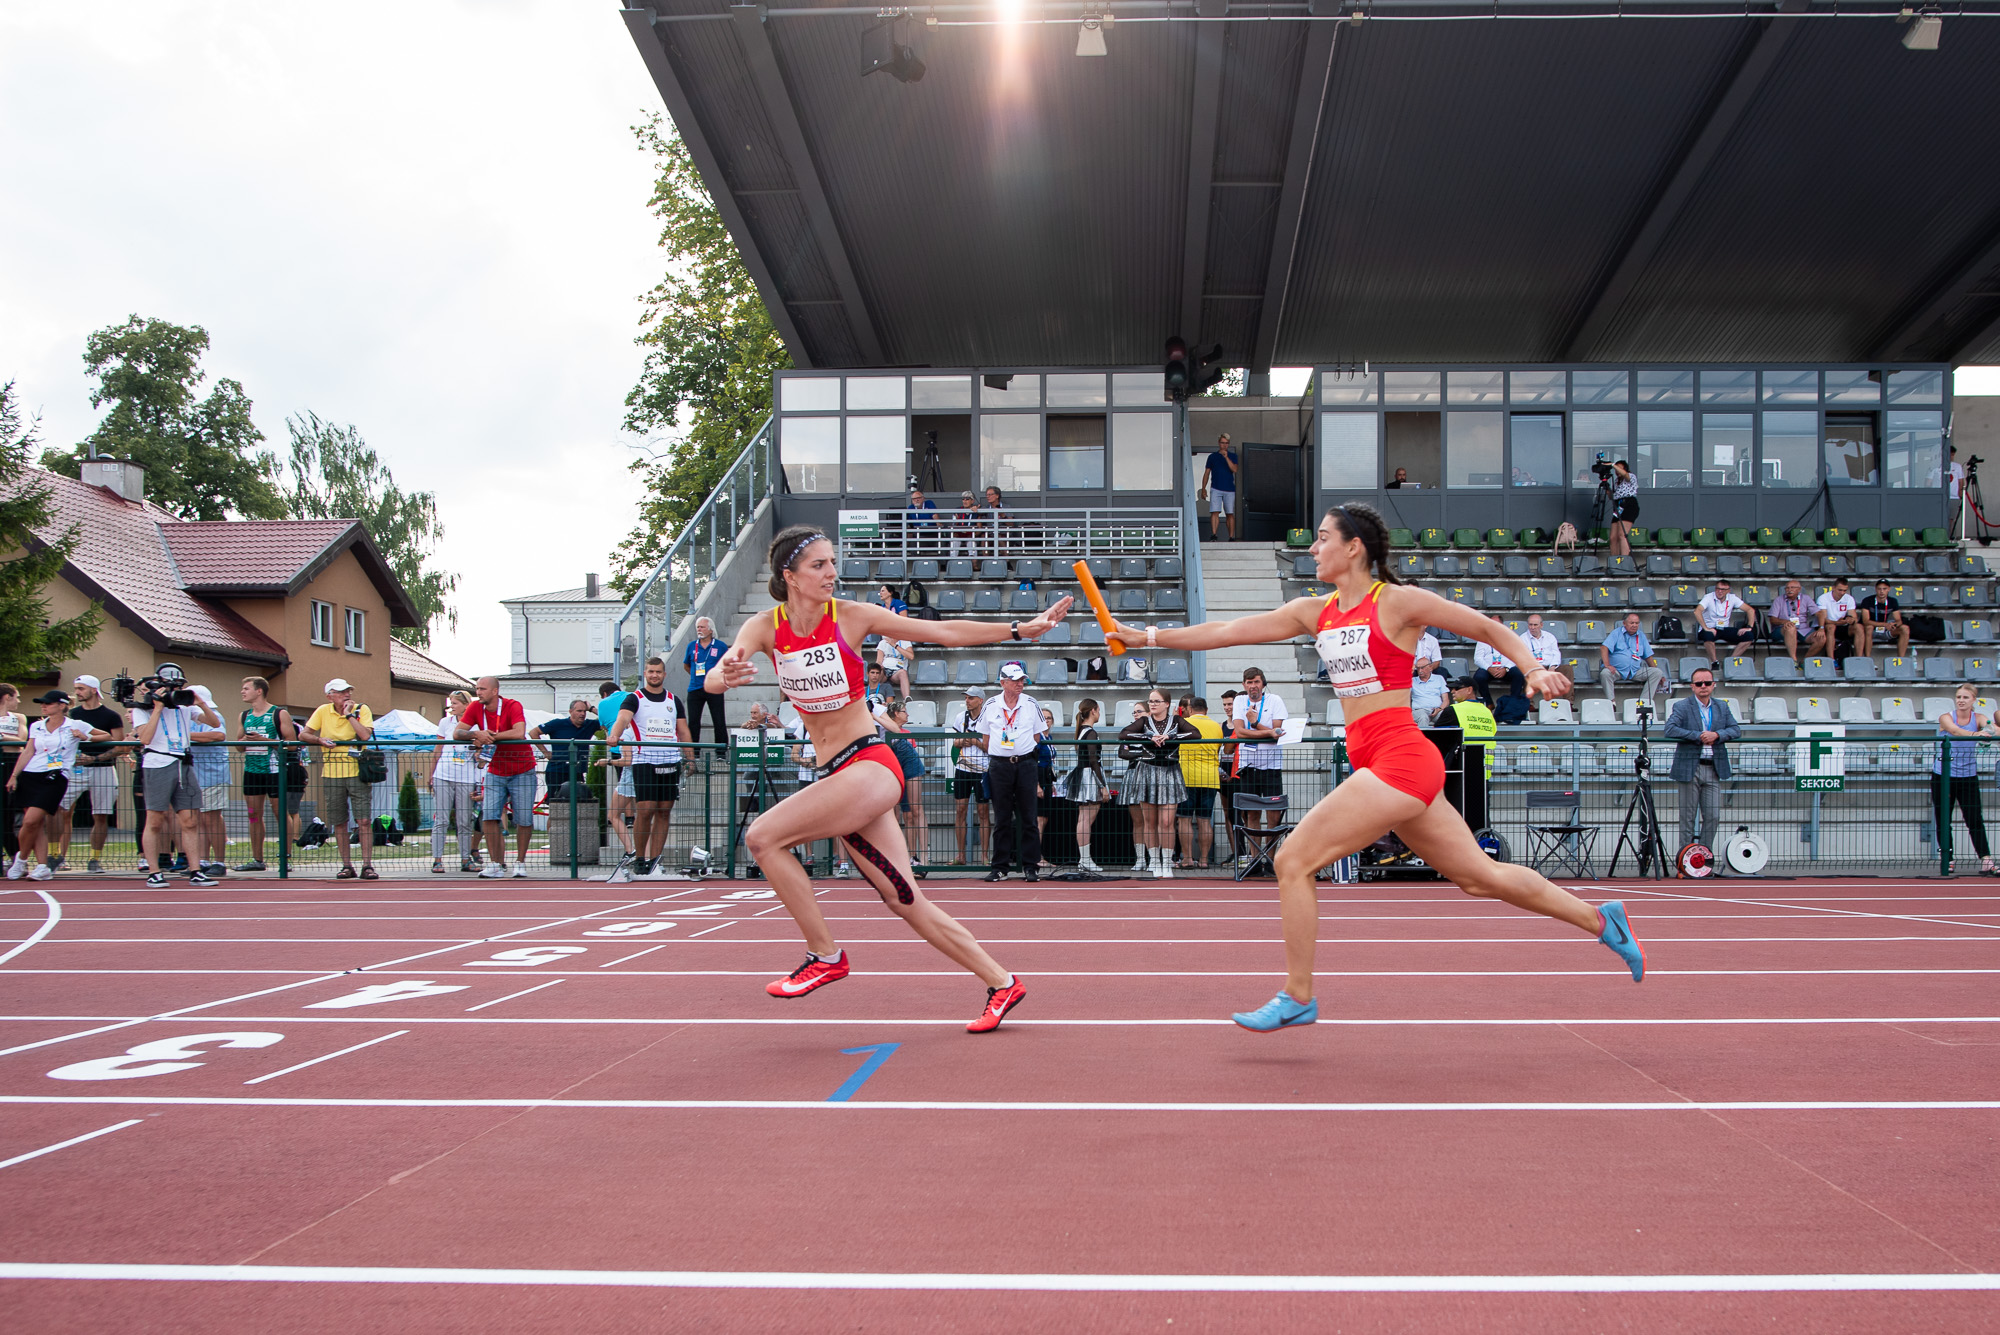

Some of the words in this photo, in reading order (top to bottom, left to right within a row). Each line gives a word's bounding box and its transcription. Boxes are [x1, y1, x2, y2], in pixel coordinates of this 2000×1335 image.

[1340, 628, 1366, 646] 287
[803, 646, 836, 667] 283
[780, 670, 845, 692] LESZCZYŃSKA
[1353, 686, 1370, 696] 2021
[824, 701, 841, 709] 2021
[1810, 731, 1833, 770] F
[1800, 778, 1840, 788] SEKTOR
[462, 946, 588, 968] 5
[302, 980, 472, 1009] 4
[46, 1032, 285, 1081] 3
